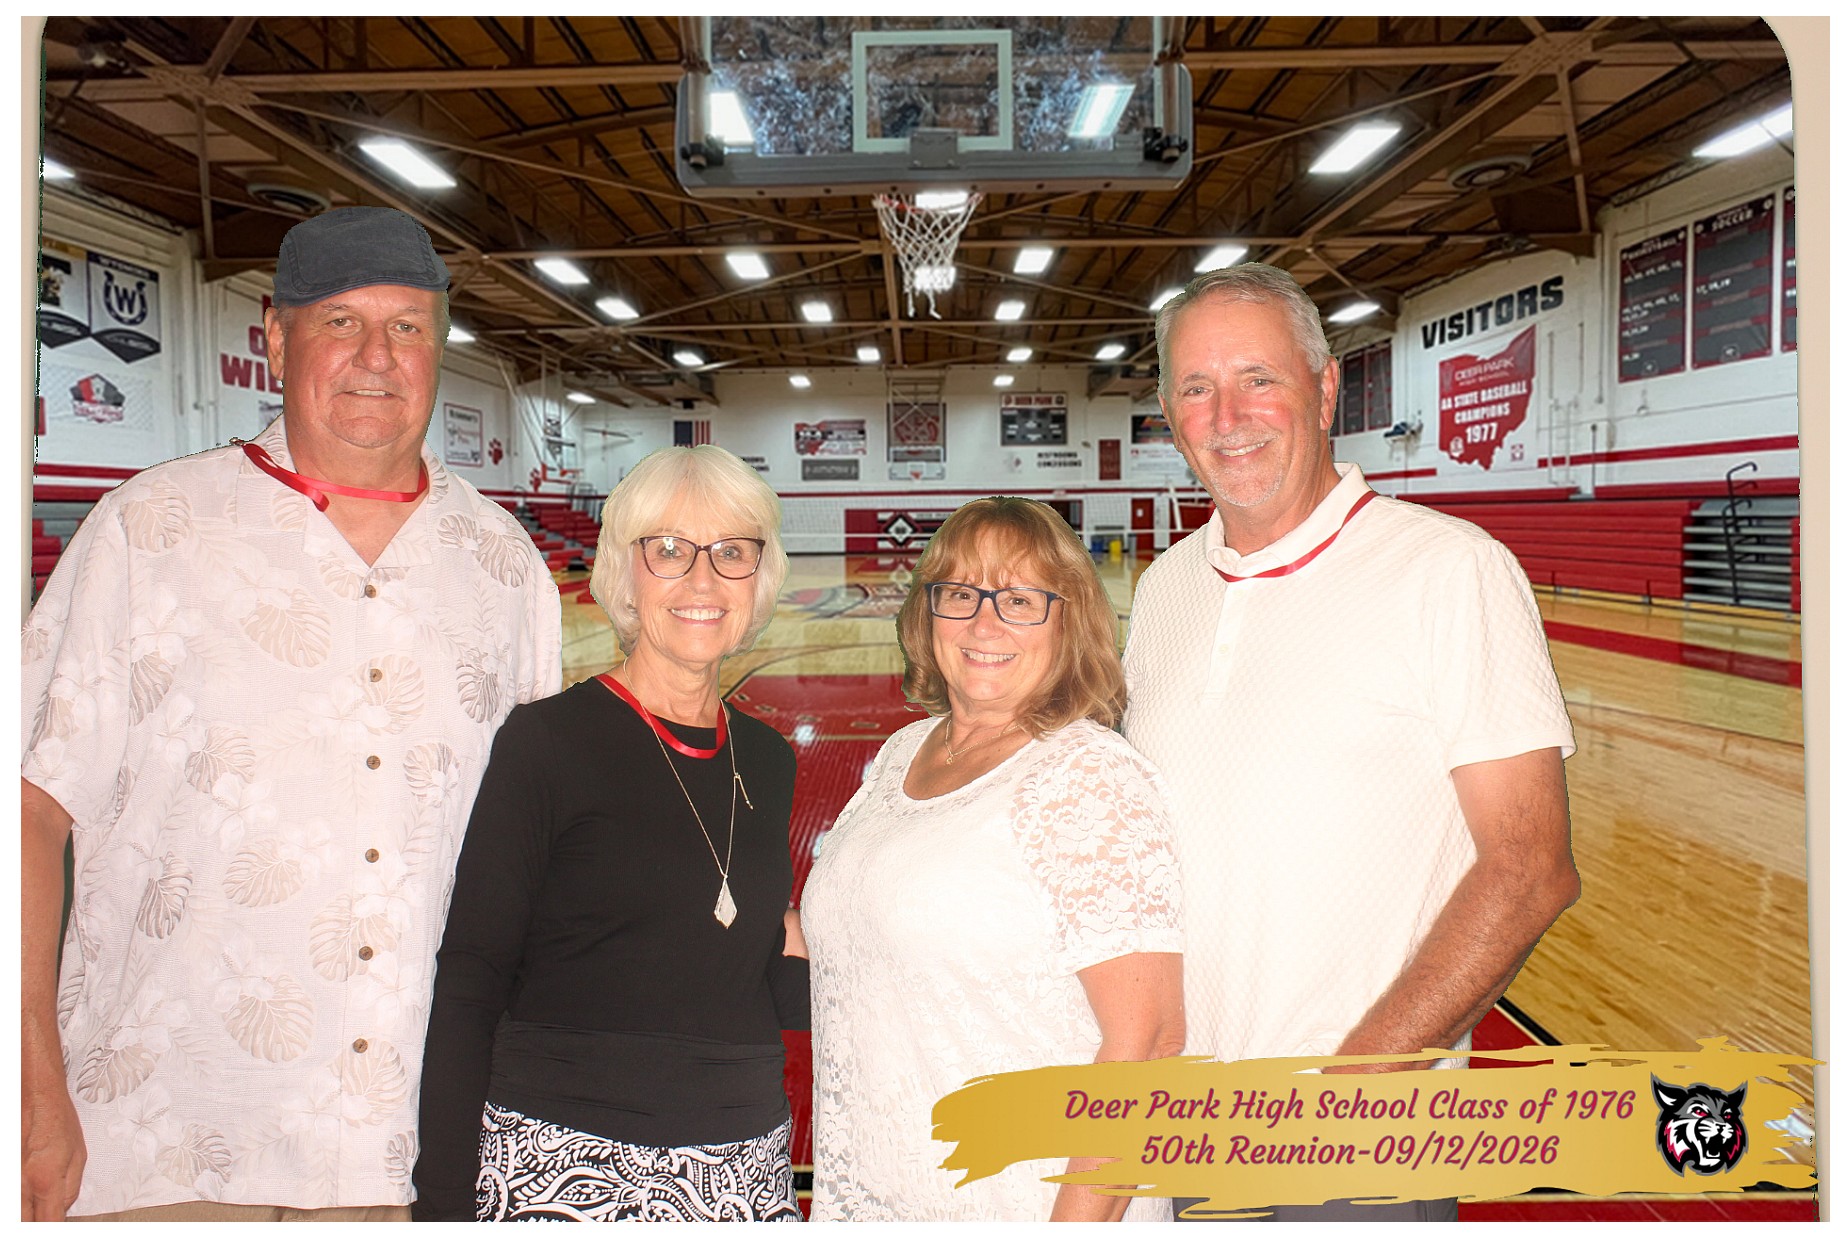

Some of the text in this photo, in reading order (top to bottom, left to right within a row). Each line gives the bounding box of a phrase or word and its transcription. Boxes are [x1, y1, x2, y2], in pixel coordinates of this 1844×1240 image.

[114, 285, 137, 314] W
[1421, 275, 1564, 350] VISITORS
[1483, 356, 1515, 375] PARK
[1441, 380, 1528, 411] AA STATE BASEBALL
[1454, 402, 1511, 425] CHAMPIONS
[1465, 422, 1499, 444] 1977
